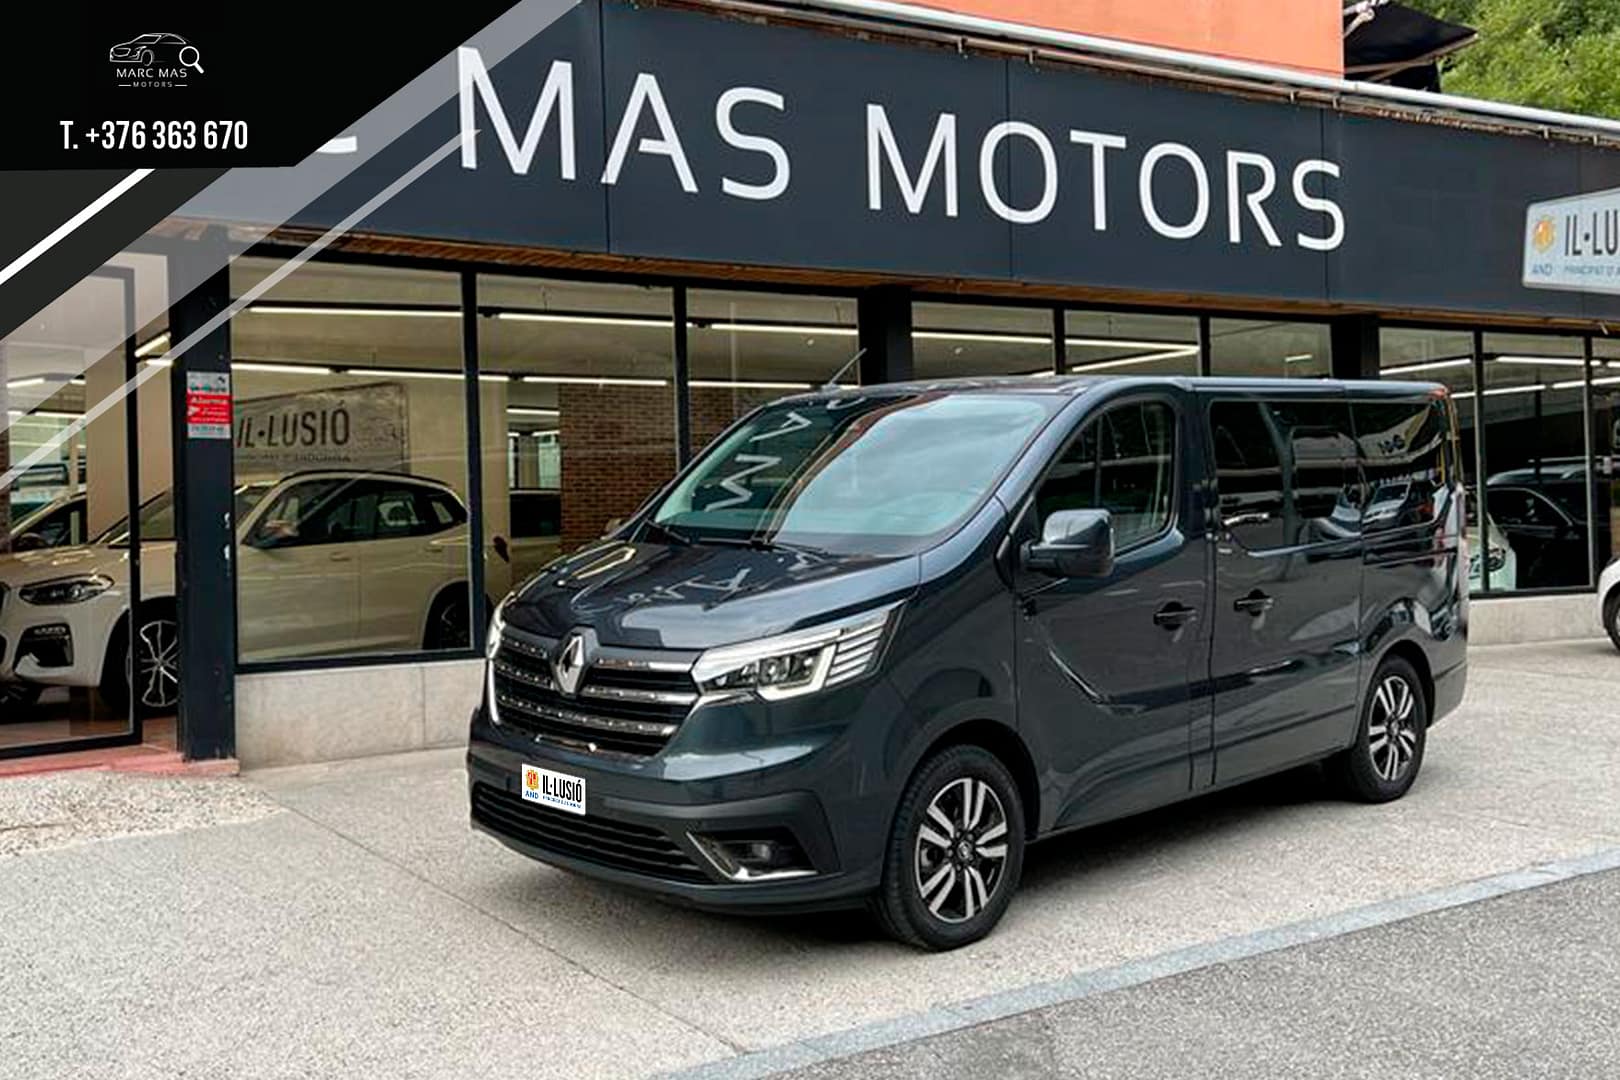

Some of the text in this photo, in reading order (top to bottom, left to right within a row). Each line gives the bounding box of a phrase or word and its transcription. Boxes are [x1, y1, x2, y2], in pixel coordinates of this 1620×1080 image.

[457, 46, 1346, 252] MAS MOTORS
[525, 790, 539, 799] AND
